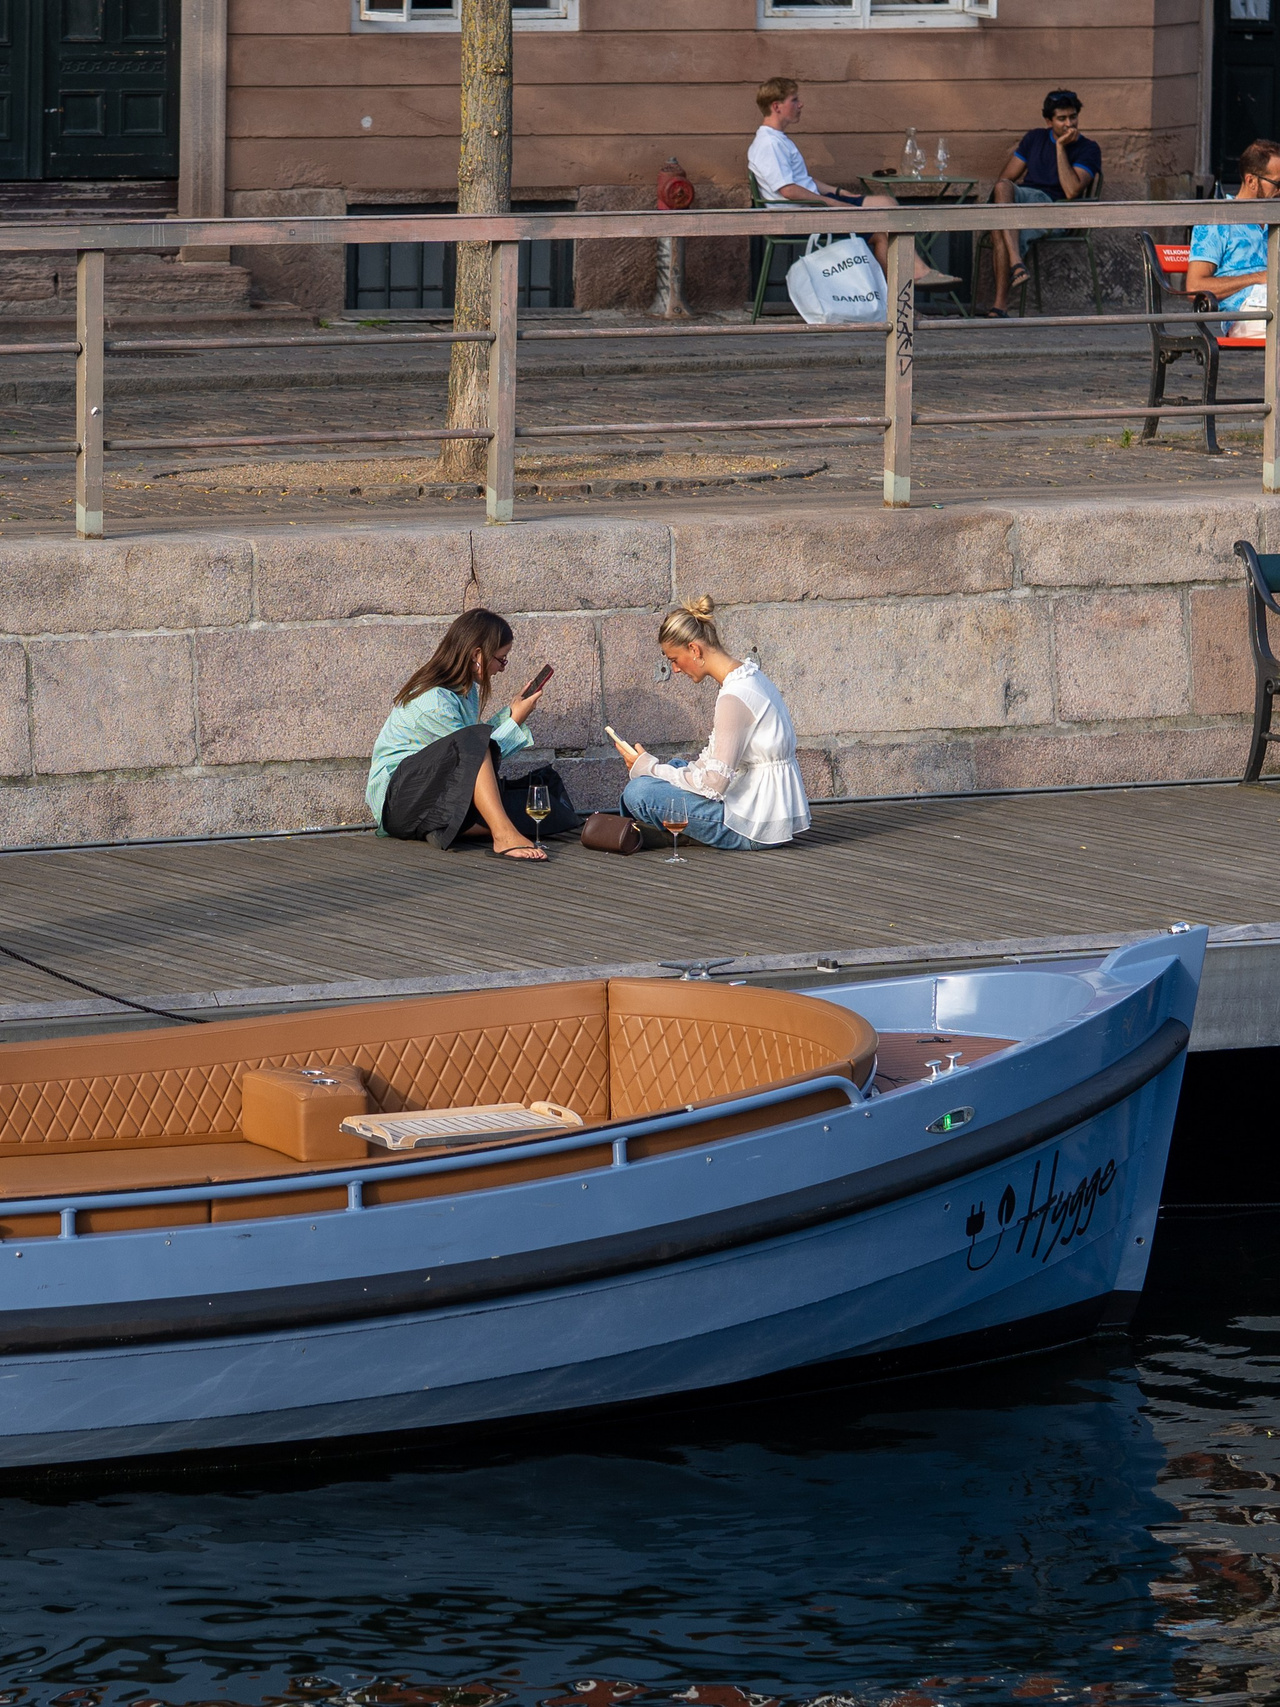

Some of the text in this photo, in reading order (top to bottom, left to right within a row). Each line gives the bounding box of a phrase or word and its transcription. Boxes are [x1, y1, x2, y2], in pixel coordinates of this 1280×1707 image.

[822, 255, 870, 278] SAMSØE
[832, 290, 881, 303] SAMSØE
[1015, 1150, 1117, 1264] Hygge
